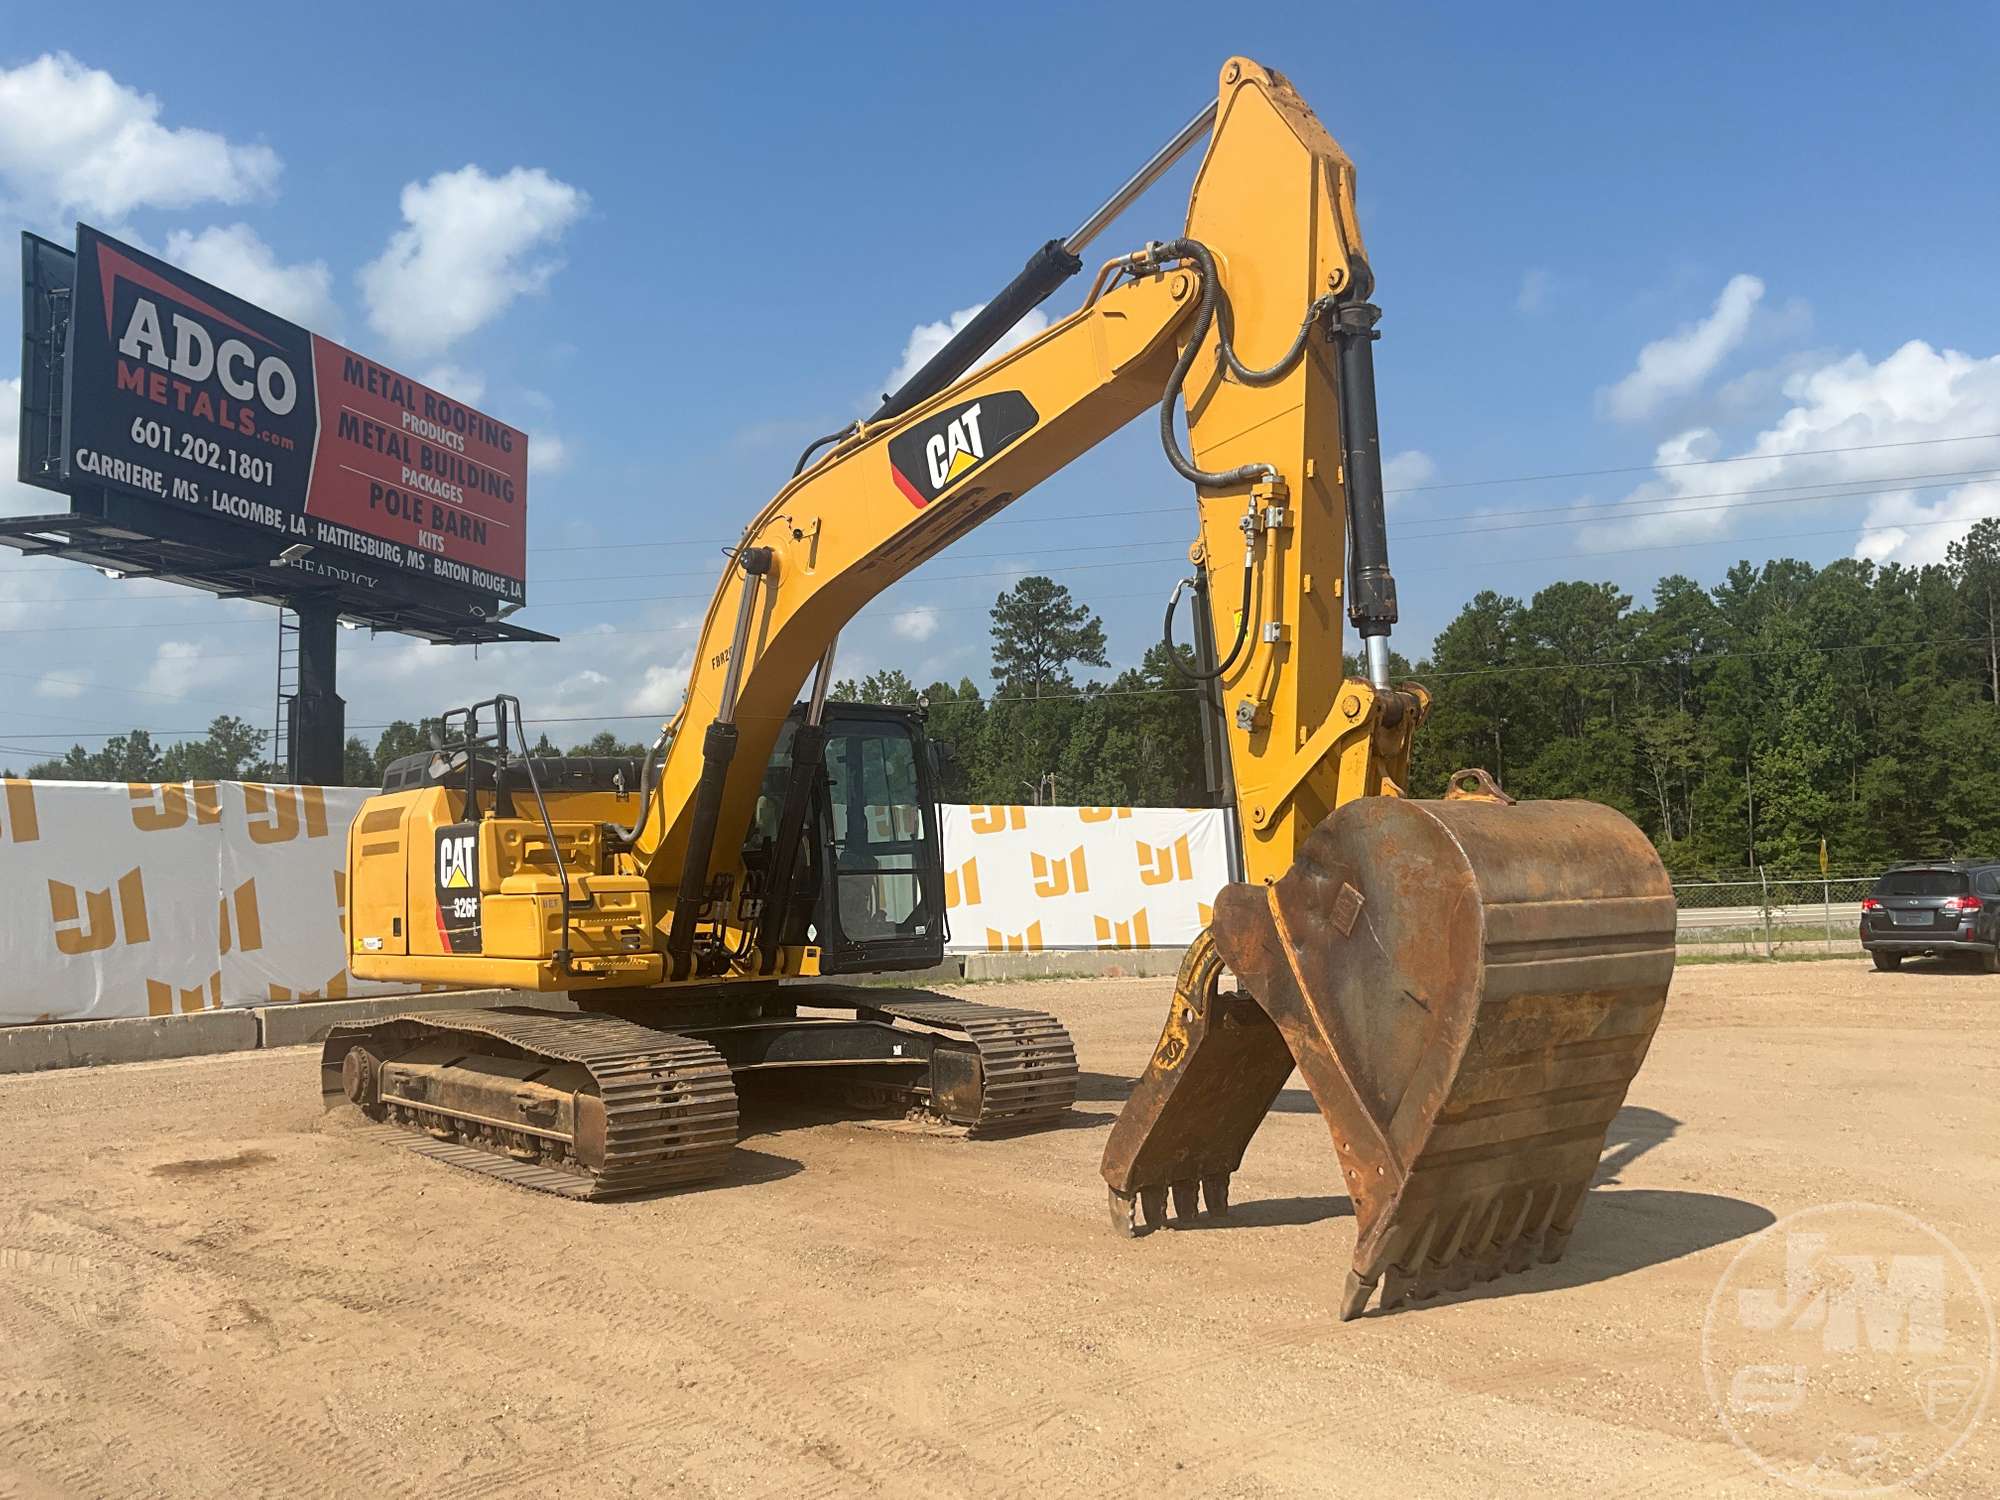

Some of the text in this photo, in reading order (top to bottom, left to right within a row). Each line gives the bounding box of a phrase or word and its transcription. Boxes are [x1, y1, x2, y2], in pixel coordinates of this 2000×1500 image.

[119, 297, 297, 415] ADCO
[343, 356, 513, 453] METAL ROOFING
[402, 411, 465, 452] PRODUCTS
[131, 416, 273, 486] 601.202.1801
[338, 411, 515, 503] METAL BUILDING
[926, 402, 984, 490] CAT
[370, 482, 487, 545] POLE BARN
[402, 466, 464, 504] PACKAGES
[76, 448, 522, 599] CARRIERE, MS LACOMBE, LA HATTIESBURG, MS BATON ROUGE, LA
[418, 529, 445, 552] KITS
[440, 836, 475, 889] CAT
[454, 897, 478, 918] 326F
